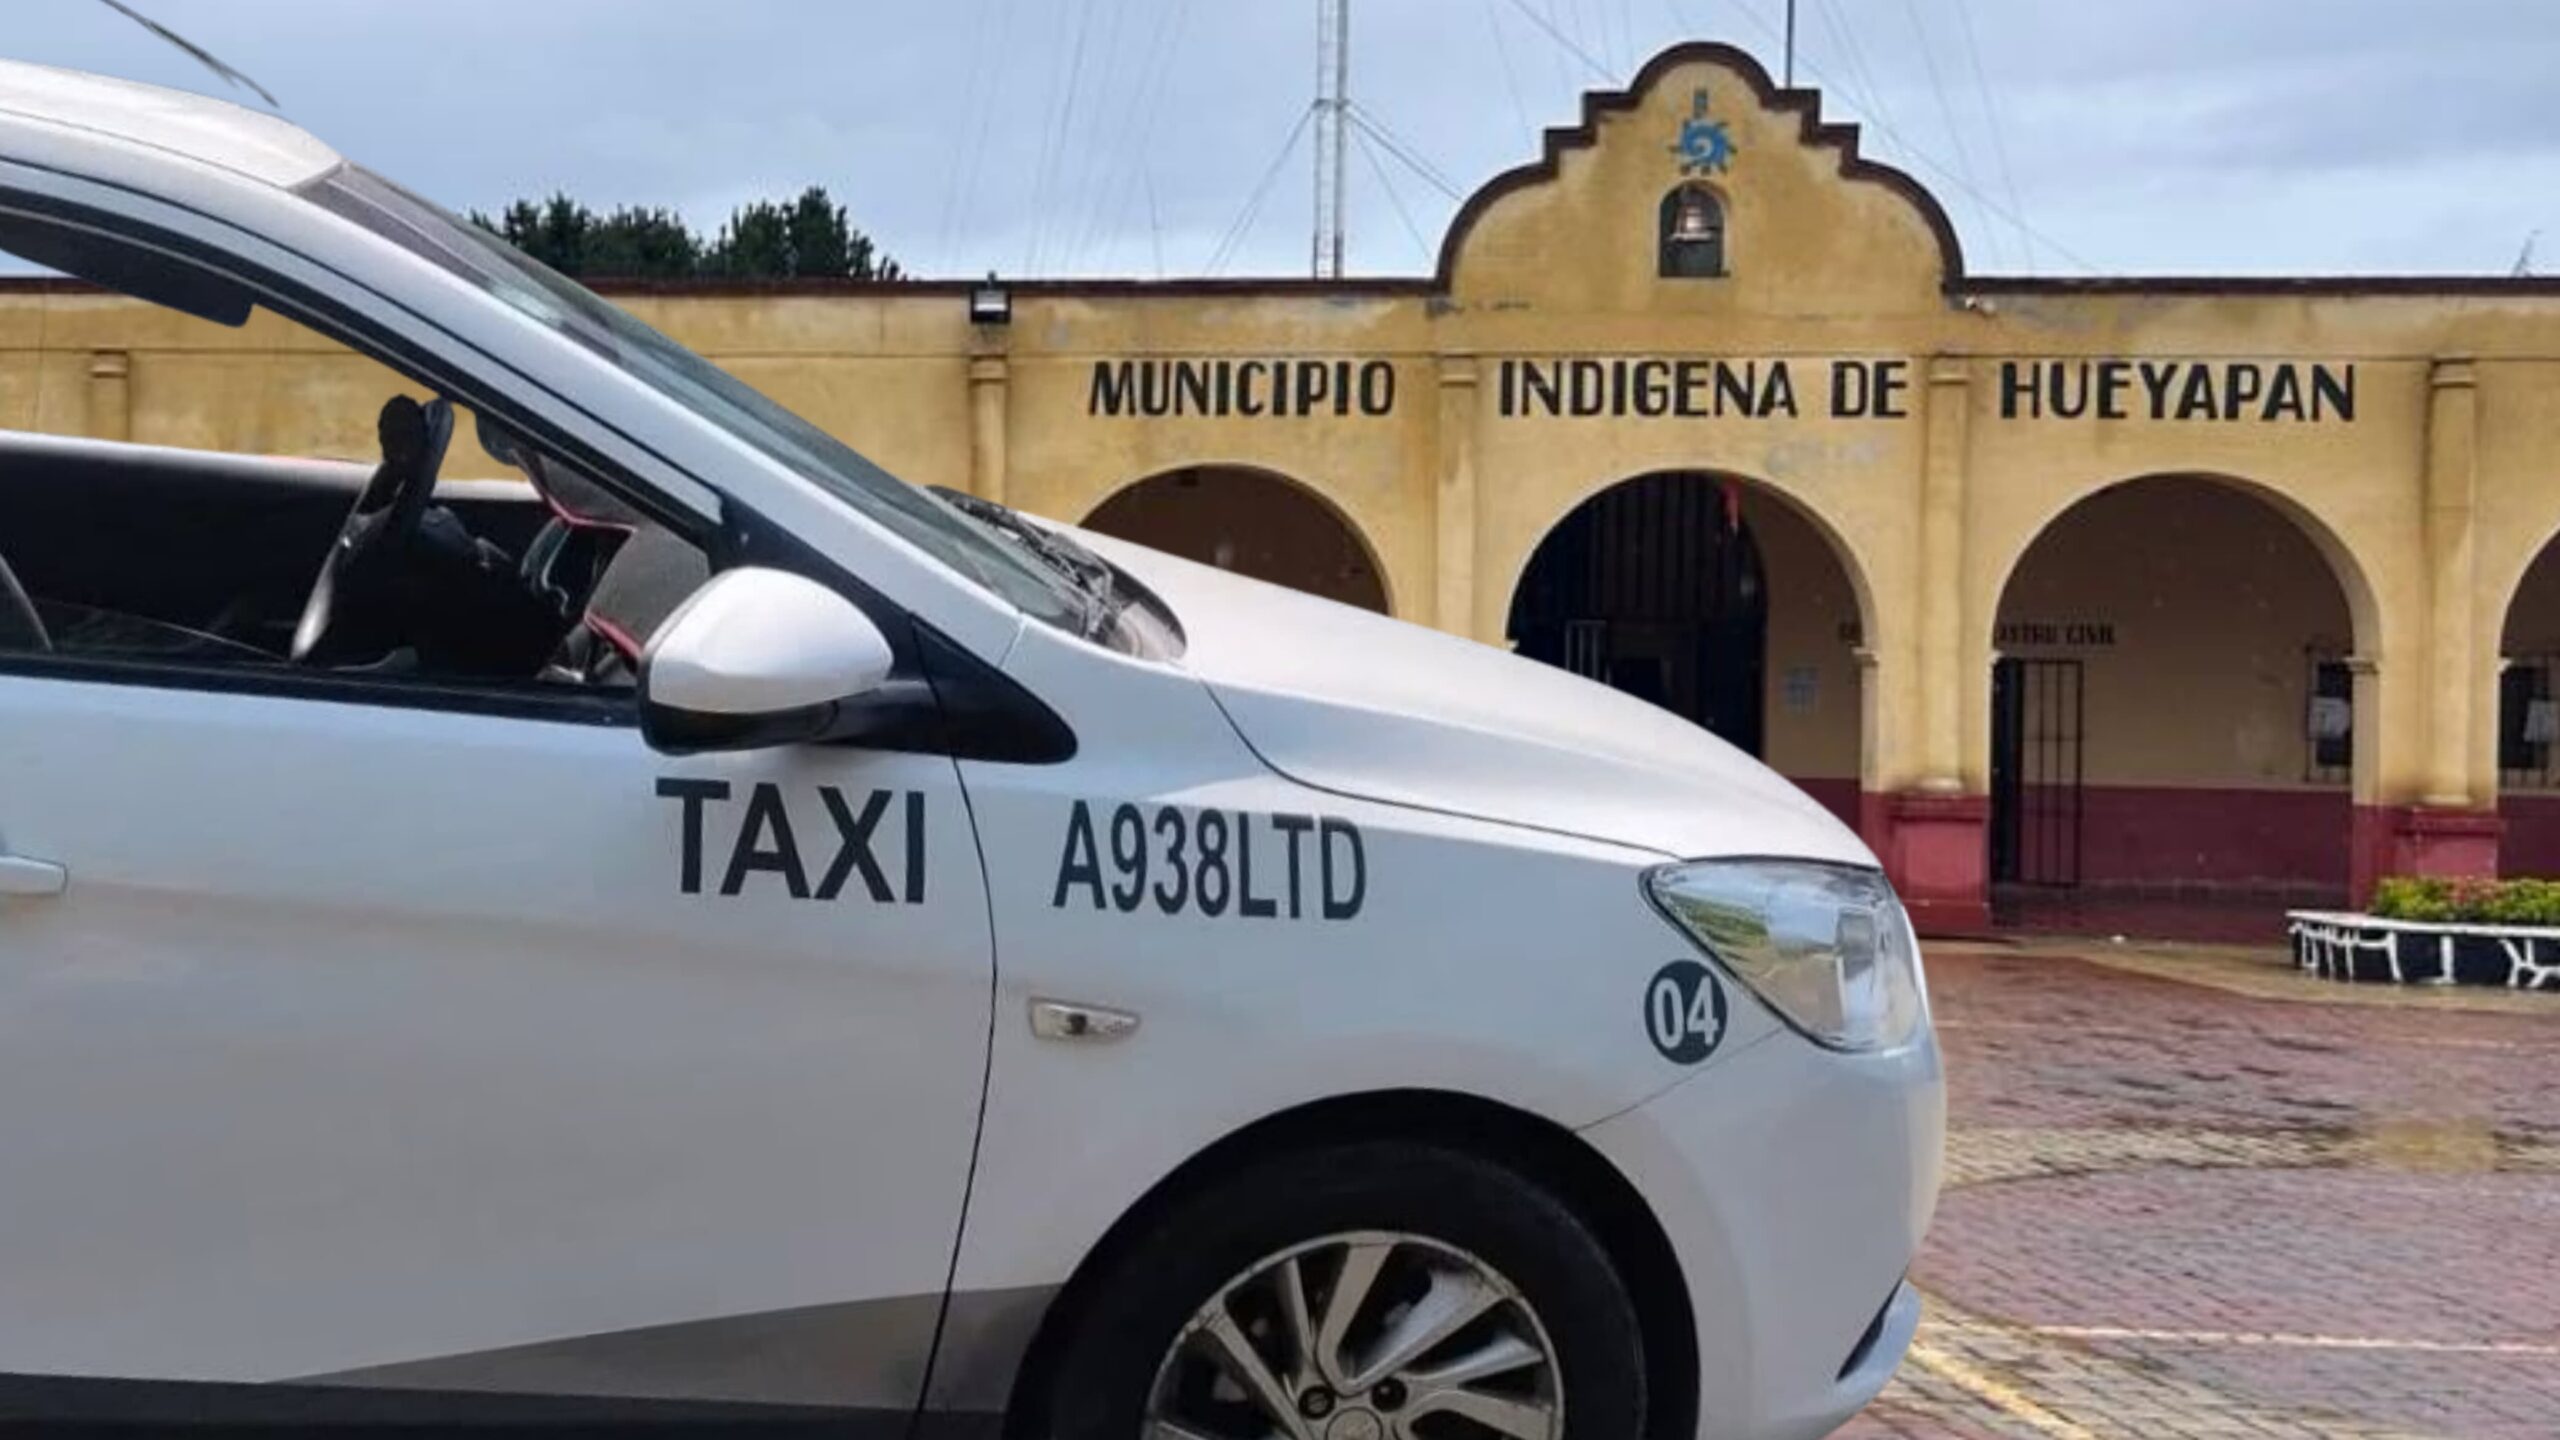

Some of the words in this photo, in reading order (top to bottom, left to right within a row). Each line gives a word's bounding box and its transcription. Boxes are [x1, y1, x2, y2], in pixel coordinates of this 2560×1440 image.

[1088, 360, 1396, 418] MUNICIPIO
[1500, 360, 1798, 418] INDIGENA
[1831, 361, 1907, 419] DE
[2001, 361, 2356, 422] HUEYAPAN
[655, 777, 926, 905] TAXI
[1053, 799, 1367, 921] A938LTD
[1653, 975, 1719, 1050] 04
